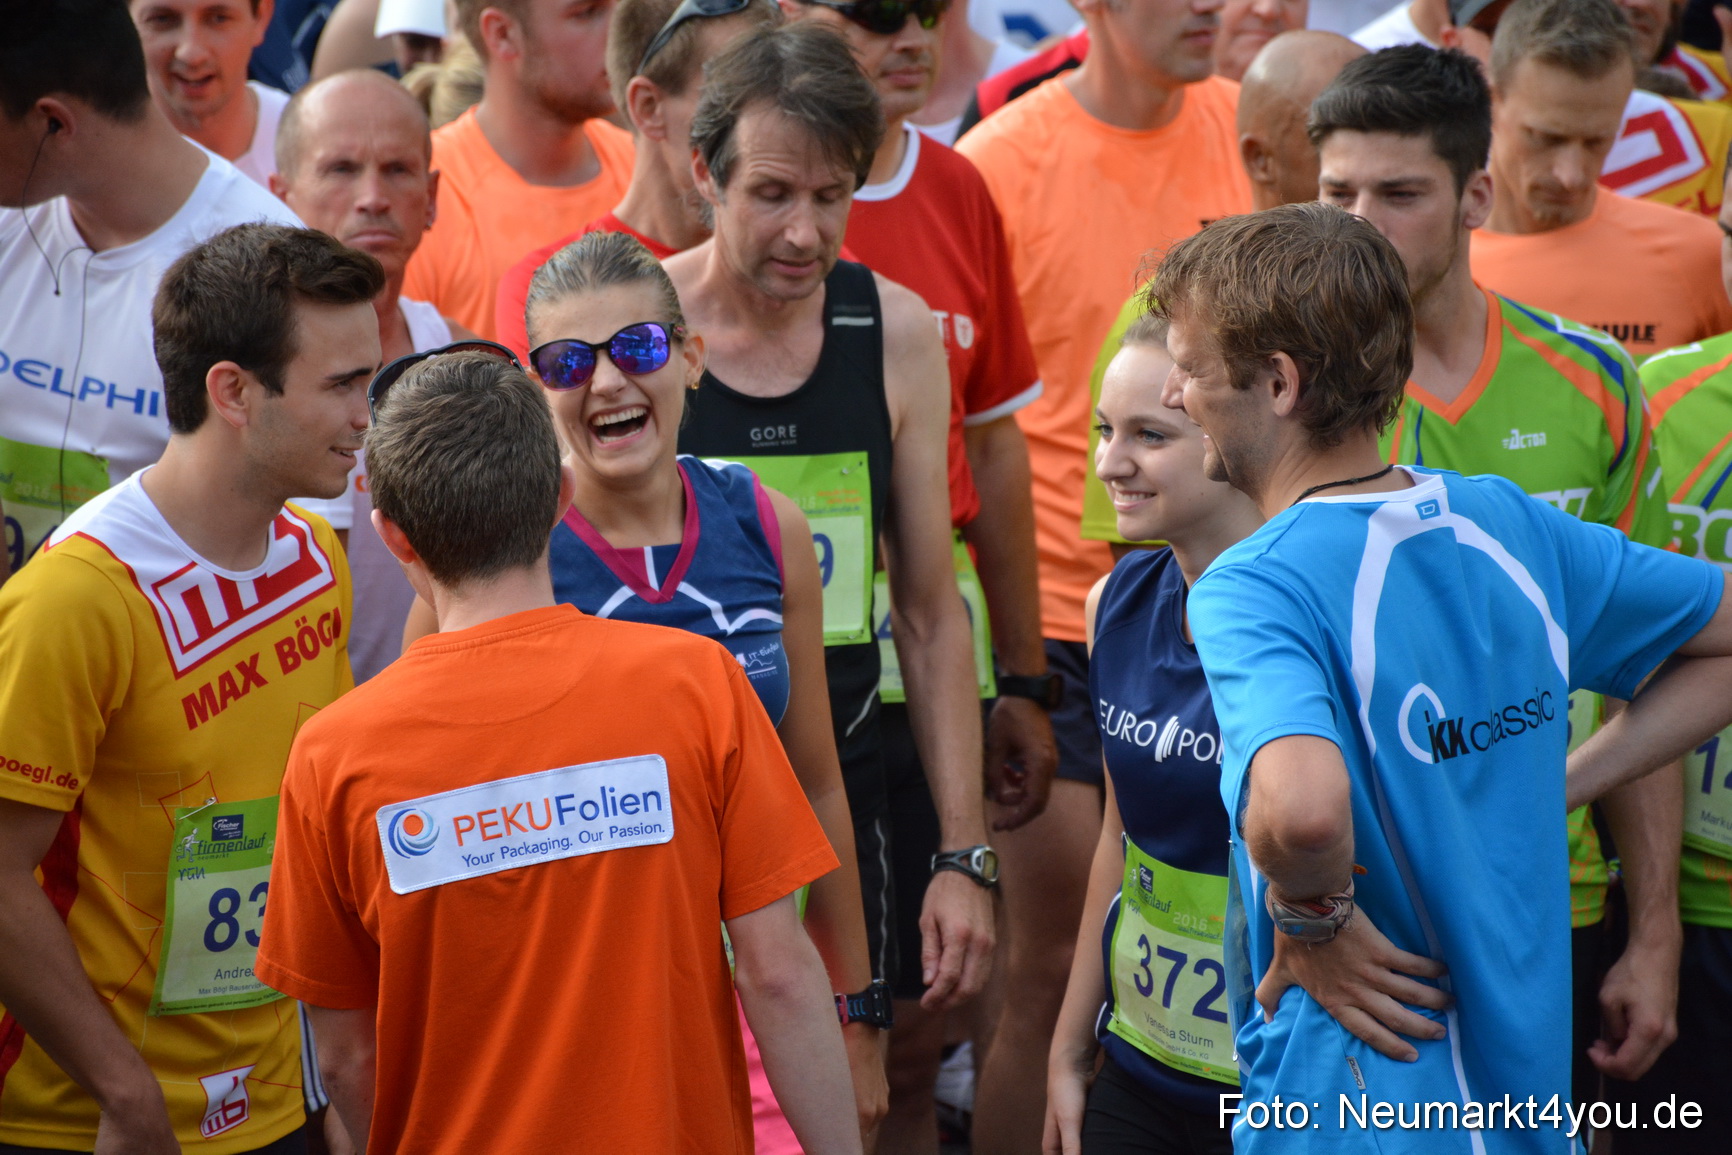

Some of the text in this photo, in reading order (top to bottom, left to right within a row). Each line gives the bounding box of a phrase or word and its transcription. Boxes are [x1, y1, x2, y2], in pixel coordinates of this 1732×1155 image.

[750, 424, 797, 441] GORE
[181, 652, 269, 731] MAX
[1469, 687, 1555, 752] classic
[197, 832, 267, 856] firmenlauf
[462, 821, 666, 868] Your Packaging. Our Passion.
[1173, 911, 1208, 931] 2016
[1133, 933, 1228, 1025] 372
[1178, 1029, 1214, 1049] Sturm
[1199, 1052, 1210, 1060] KG
